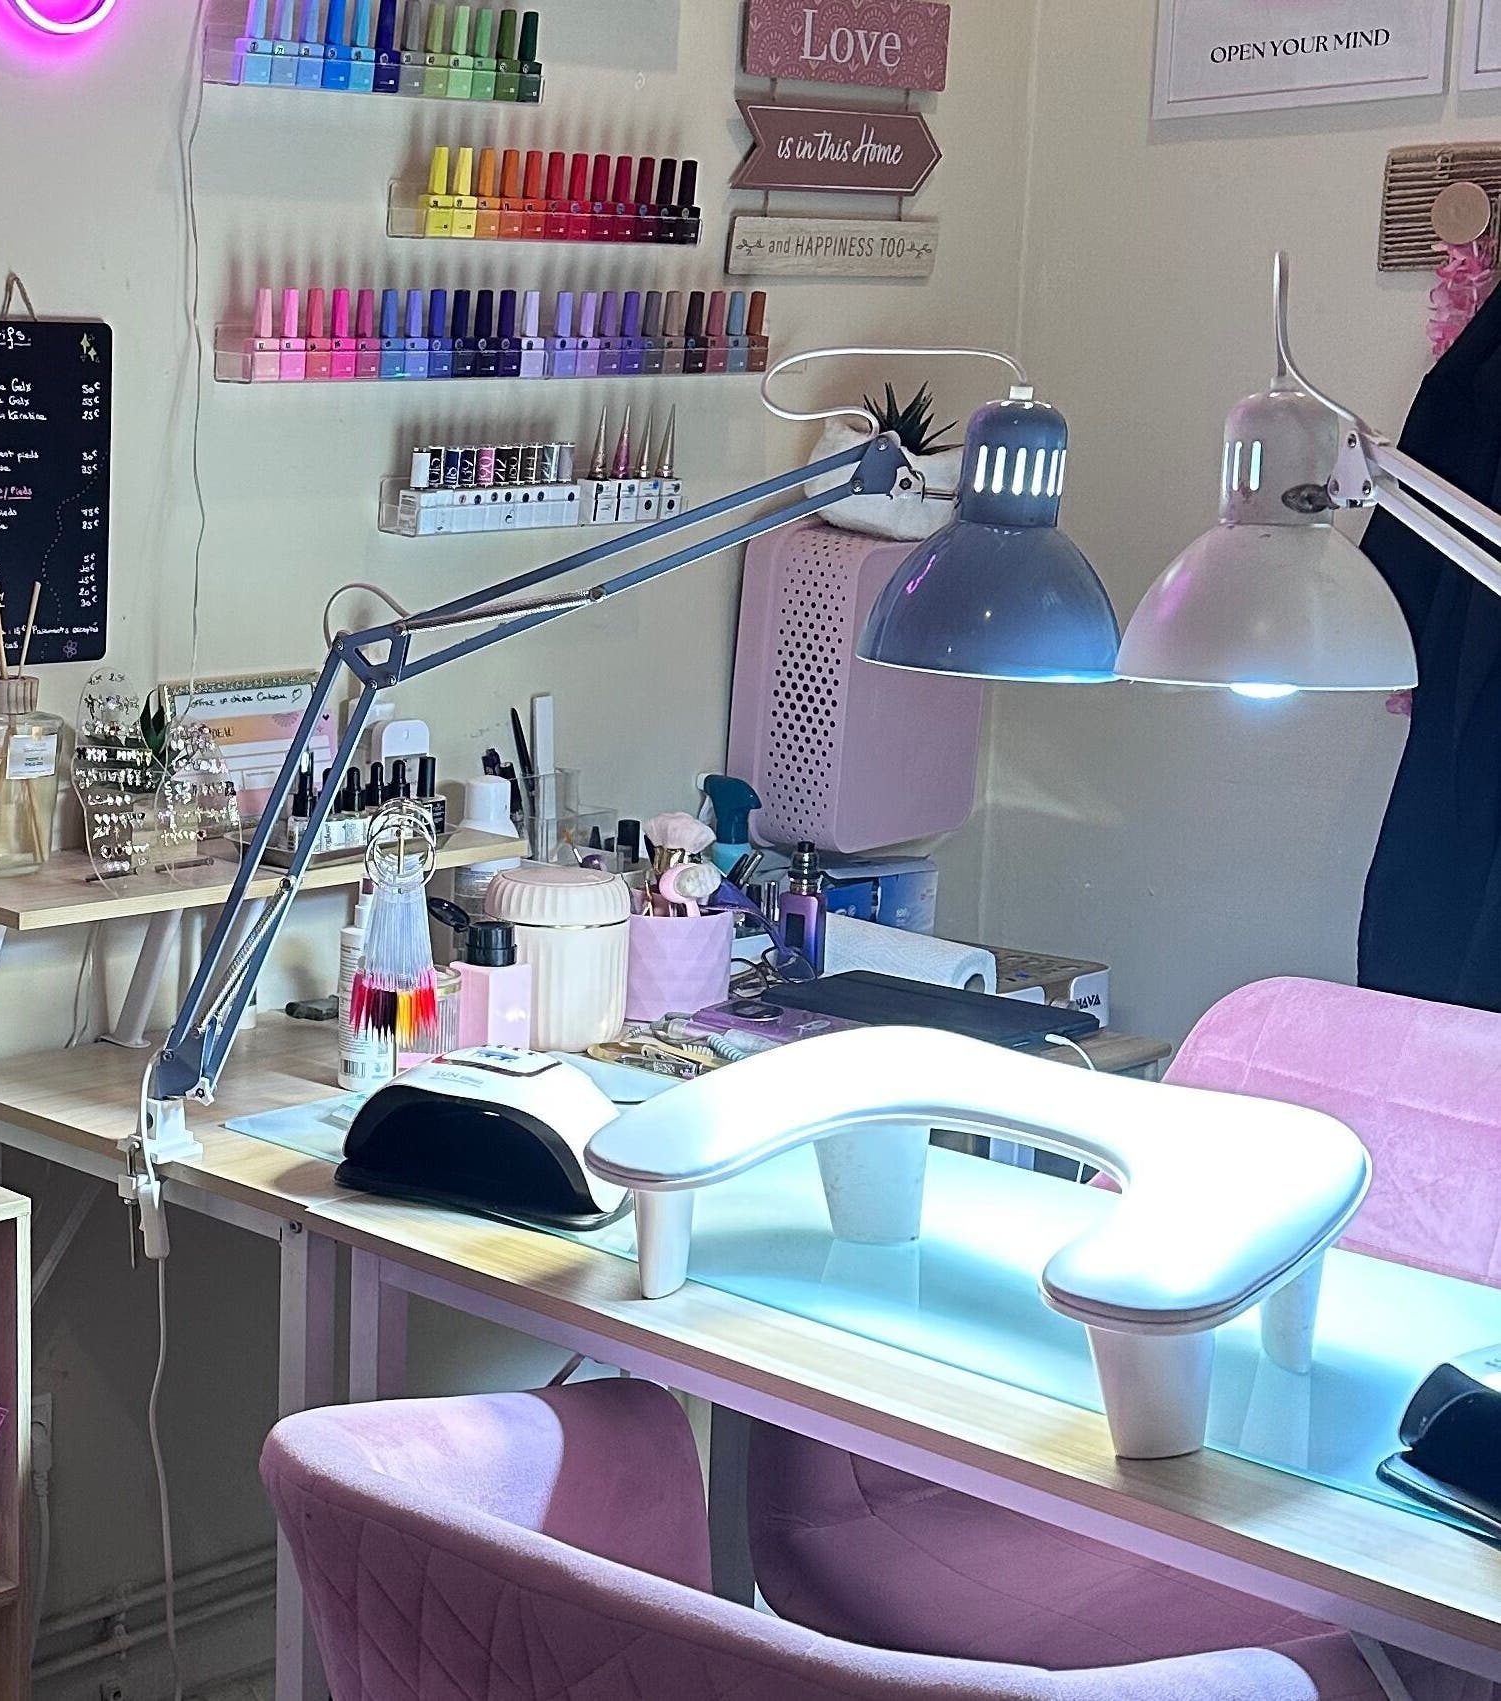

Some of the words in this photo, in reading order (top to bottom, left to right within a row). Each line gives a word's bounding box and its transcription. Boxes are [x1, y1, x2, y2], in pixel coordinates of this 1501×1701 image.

[800, 8, 901, 68] Love
[1210, 41, 1266, 63] OPEN
[1269, 35, 1329, 57] YOUR
[1333, 28, 1390, 51] MIND
[777, 134, 791, 160] is
[796, 135, 814, 161] in
[852, 123, 904, 167] Home
[768, 236, 791, 255] and
[795, 235, 875, 258] HAPPINESS
[880, 237, 906, 259] TOO
